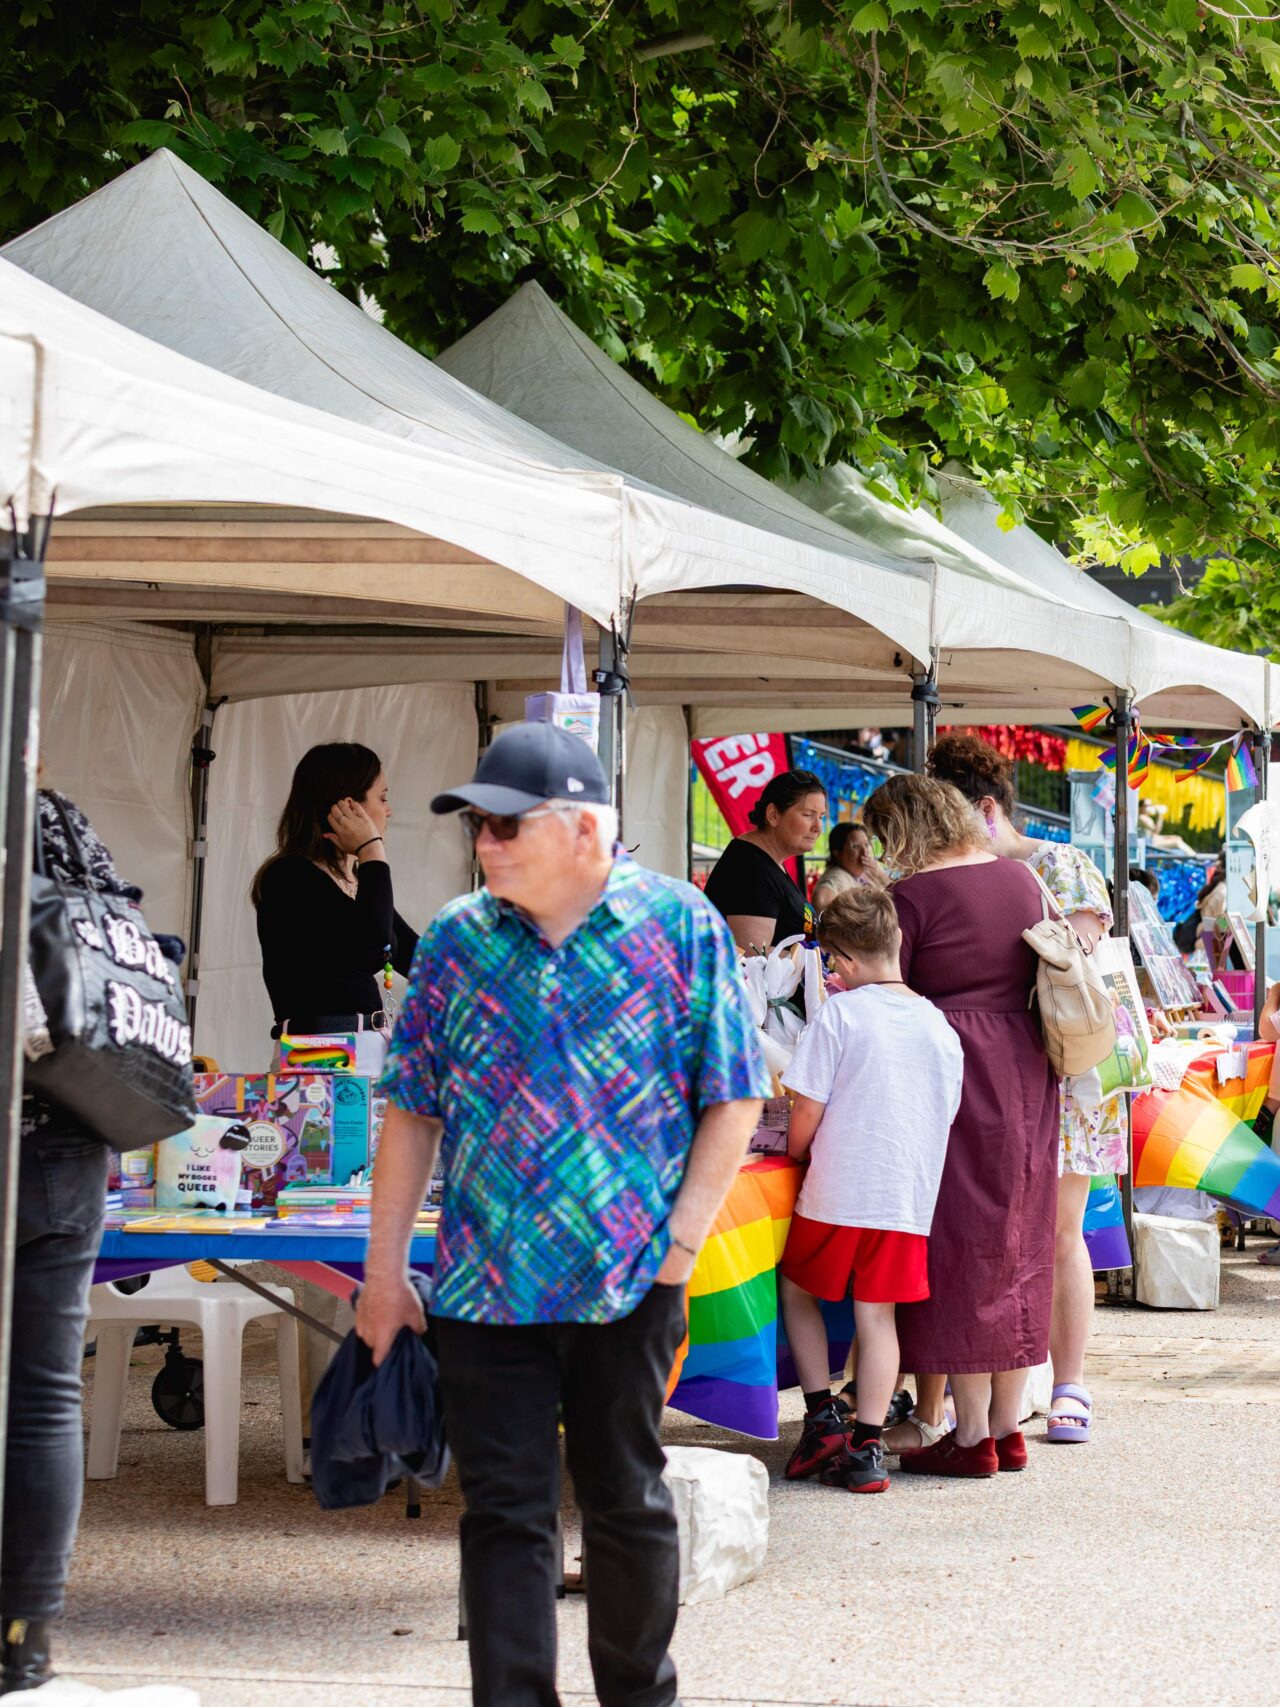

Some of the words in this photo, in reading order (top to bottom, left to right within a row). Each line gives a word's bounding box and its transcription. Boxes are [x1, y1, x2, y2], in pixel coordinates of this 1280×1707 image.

[698, 733, 775, 799] ER
[109, 981, 192, 1066] Paws
[178, 1183, 216, 1192] QUEER
